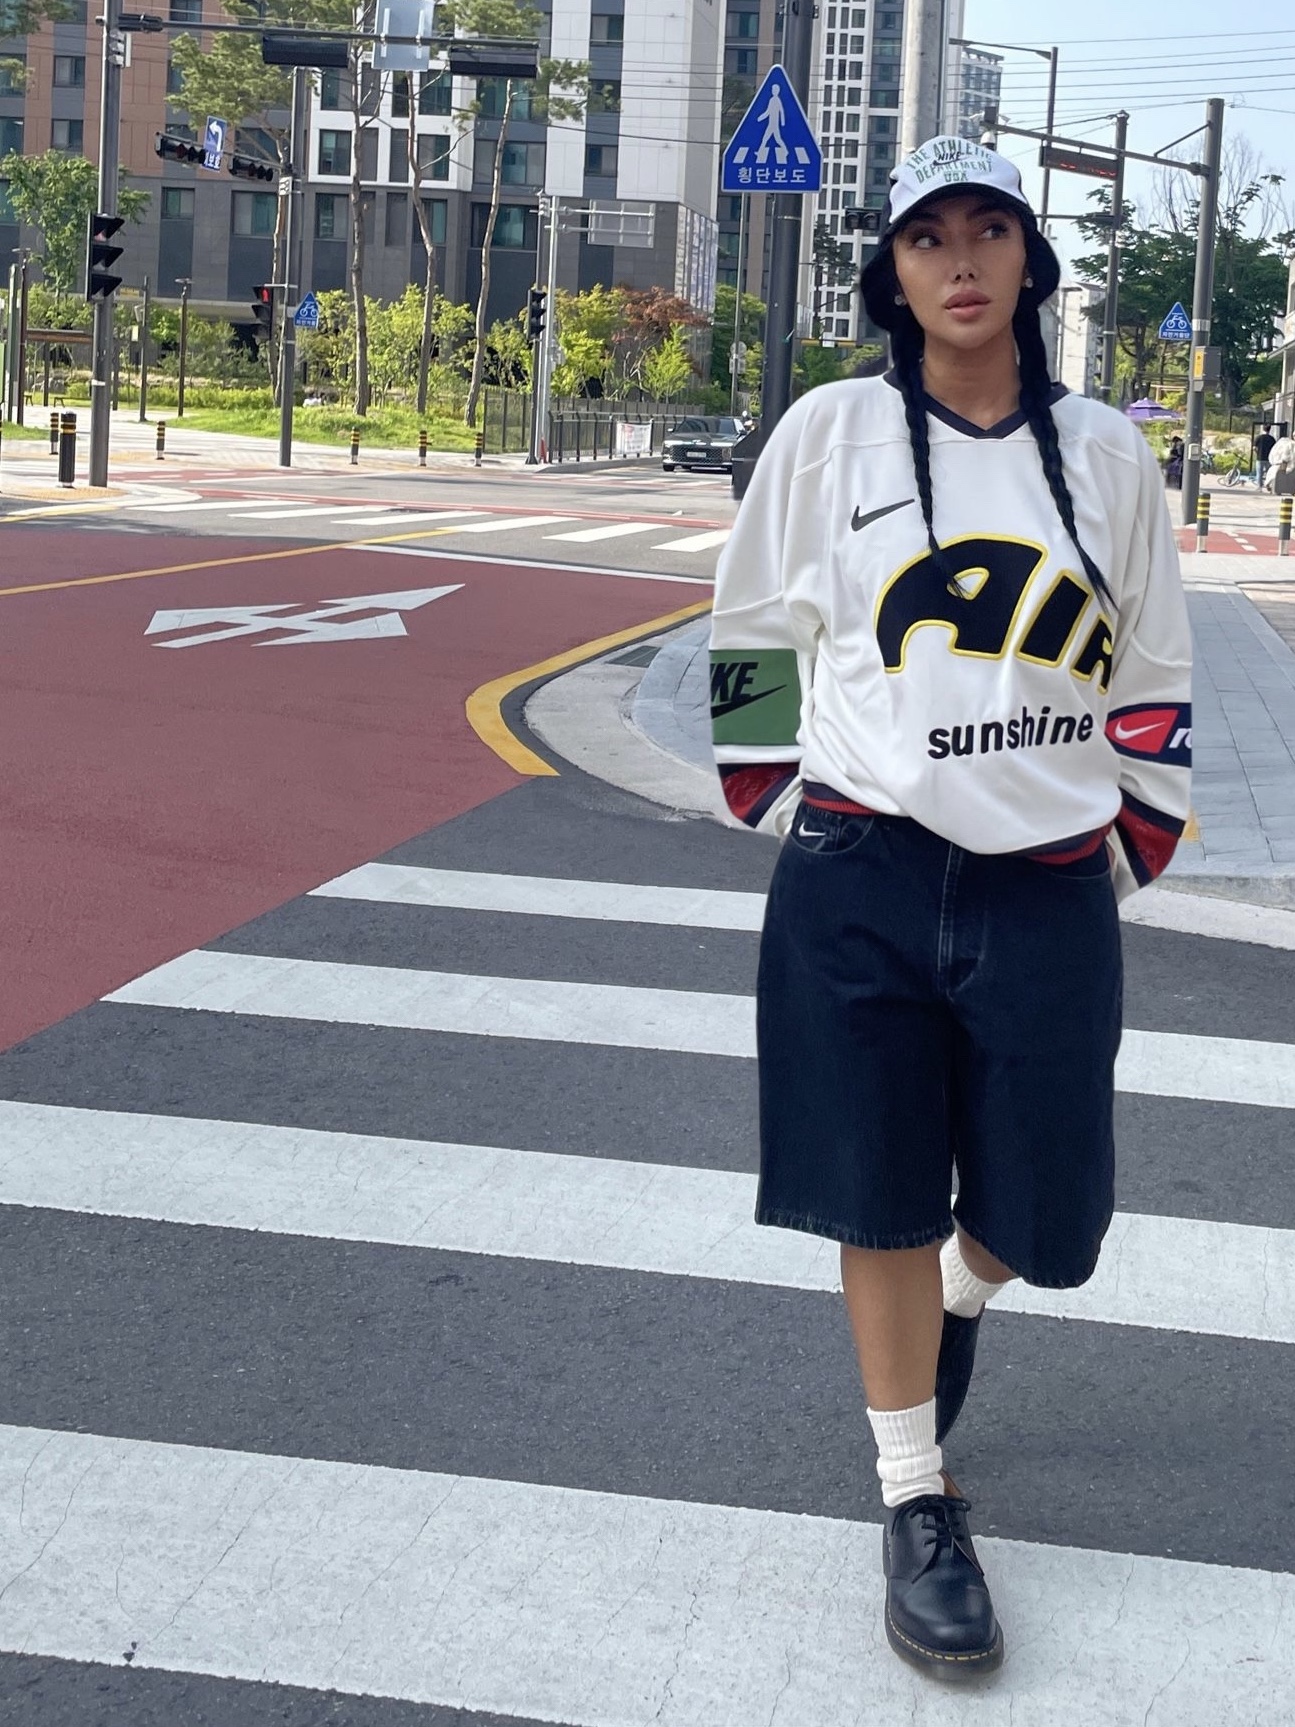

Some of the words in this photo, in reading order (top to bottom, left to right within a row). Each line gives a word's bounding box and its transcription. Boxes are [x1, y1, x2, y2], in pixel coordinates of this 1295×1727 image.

[906, 149, 930, 169] THE
[938, 151, 961, 160] NIKE
[737, 167, 807, 183] 횡단보도
[915, 160, 992, 184] DEPARTMENT
[944, 172, 969, 183] USA
[874, 533, 1113, 695] AIR
[928, 706, 1093, 760] sunshine
